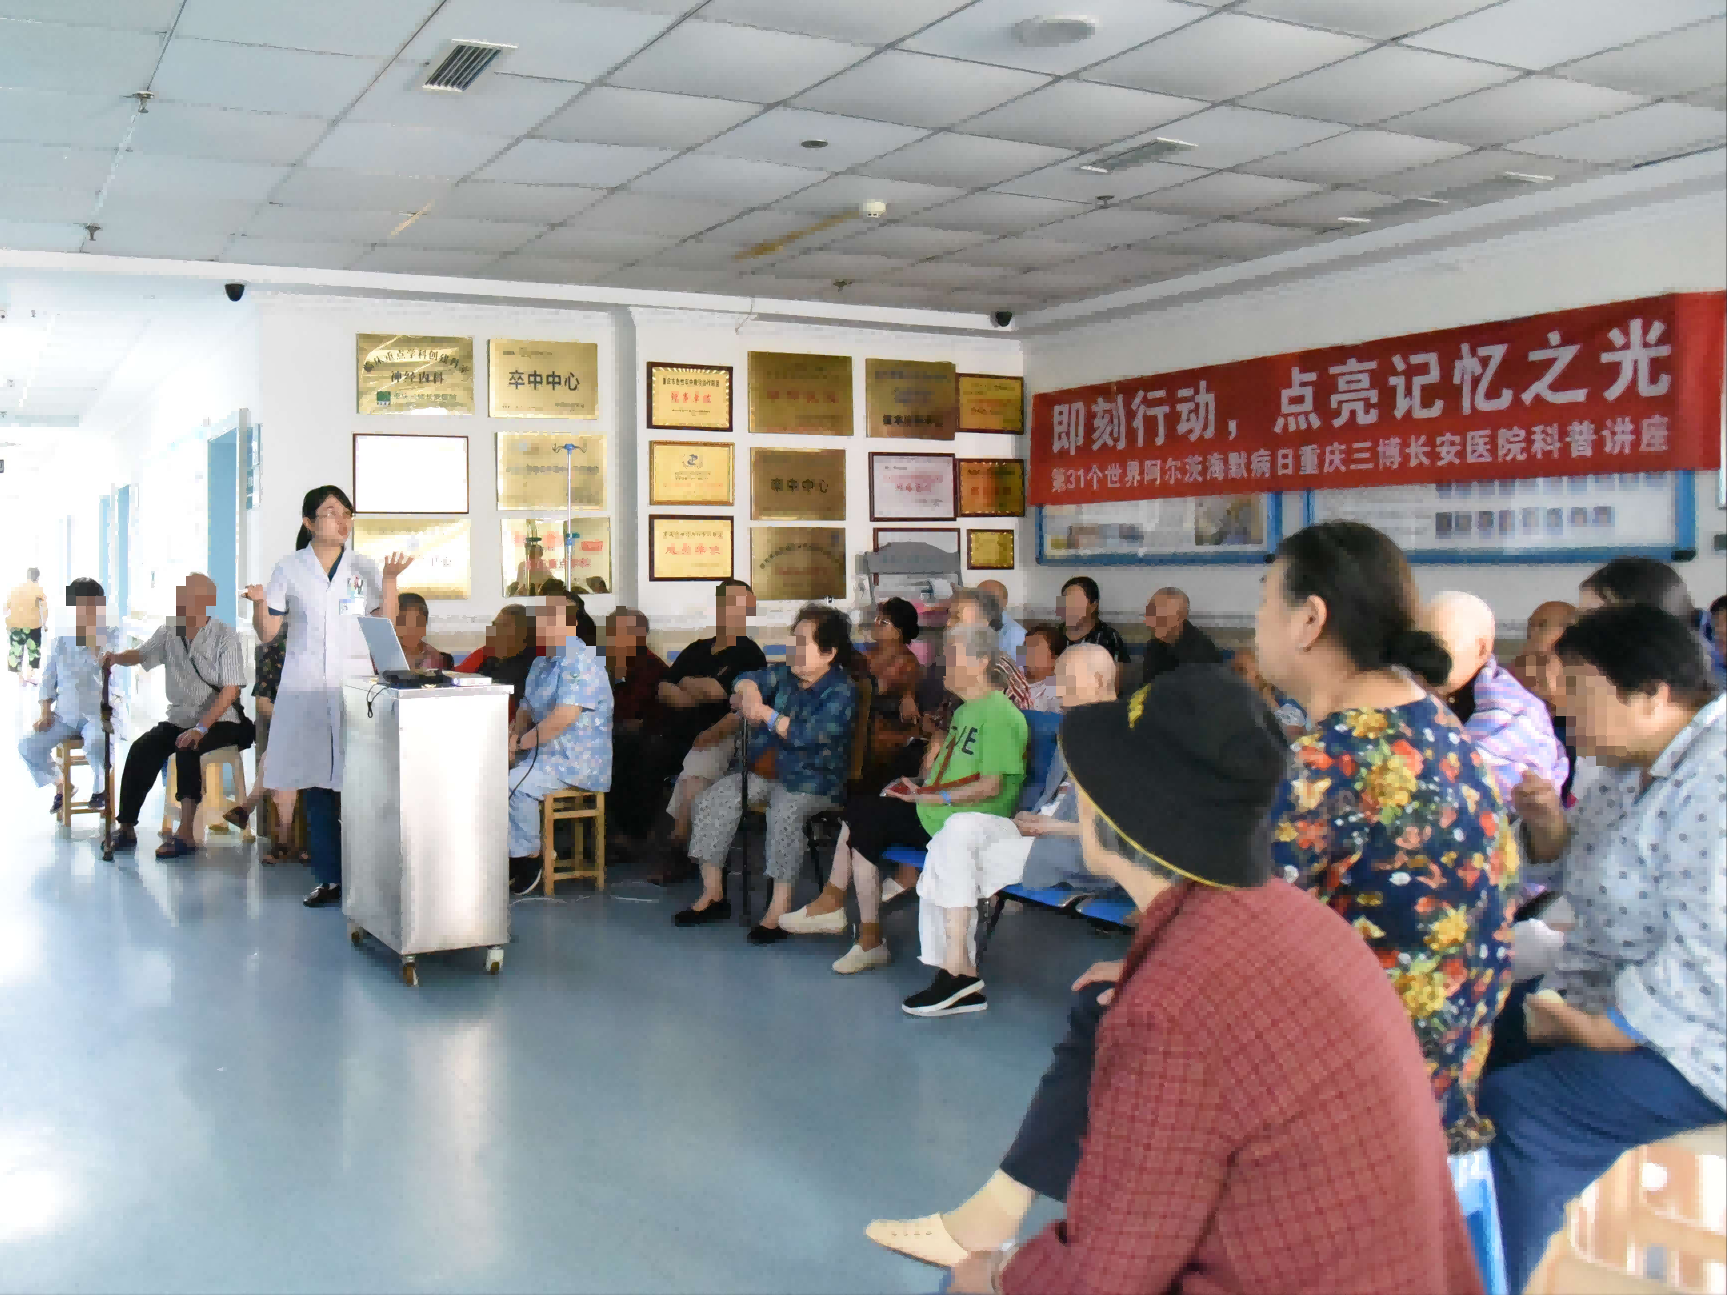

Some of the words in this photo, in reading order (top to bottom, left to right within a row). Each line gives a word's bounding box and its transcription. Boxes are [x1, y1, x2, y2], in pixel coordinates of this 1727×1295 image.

[508, 369, 580, 391] 卒中中心
[1050, 413, 1669, 493] 第31个世界阿尔茨海默病日重庆三博长安医院科普讲座
